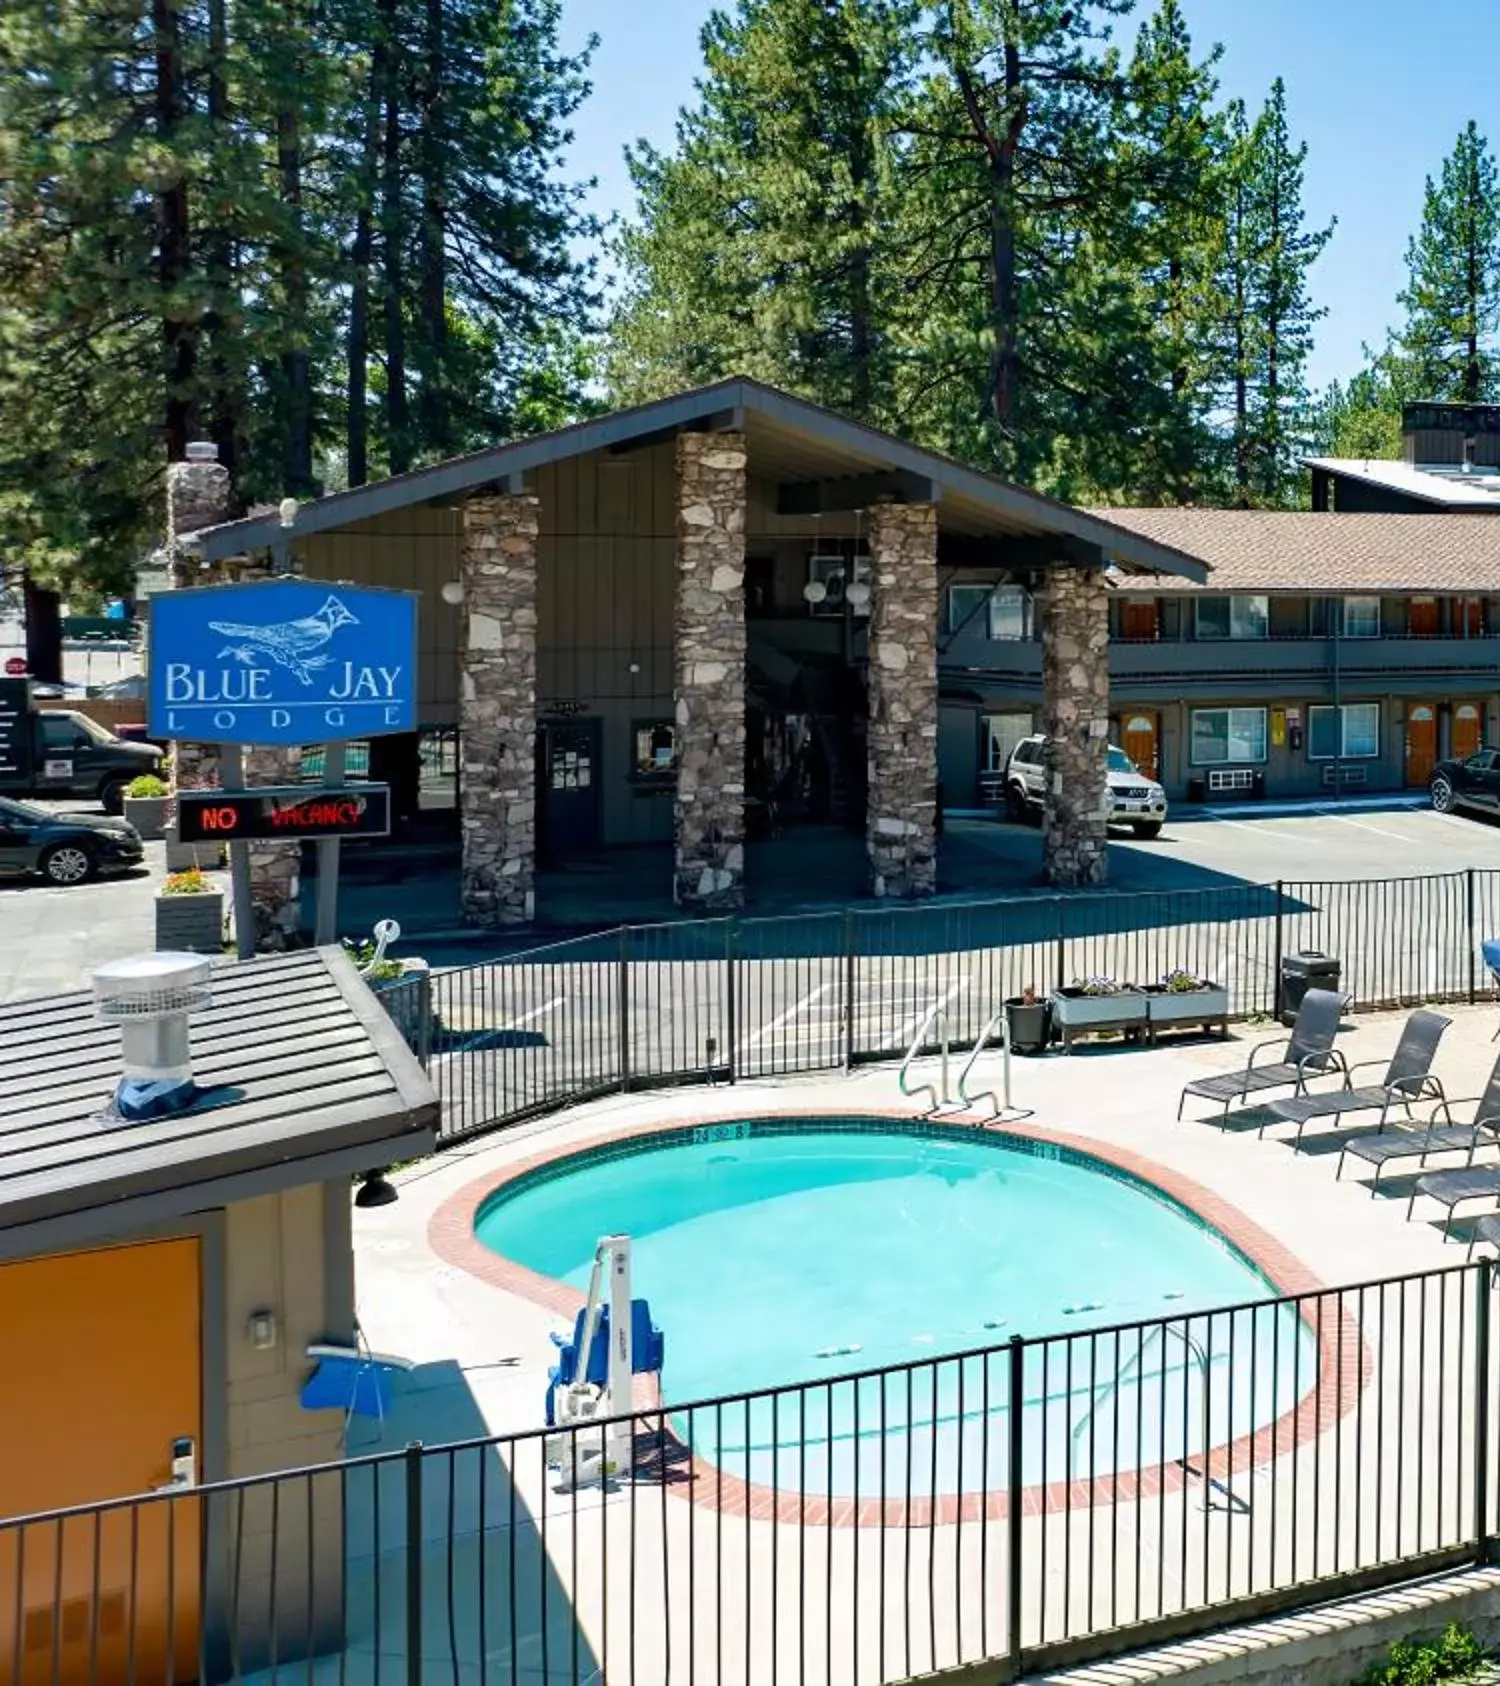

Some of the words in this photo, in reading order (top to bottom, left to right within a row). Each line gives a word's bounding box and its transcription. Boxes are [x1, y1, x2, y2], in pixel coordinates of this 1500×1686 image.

[166, 663, 272, 701] BLUE
[329, 661, 402, 698] JAY
[167, 706, 400, 731] LODGE
[202, 807, 238, 830] NO
[271, 803, 361, 827] VACANCY
